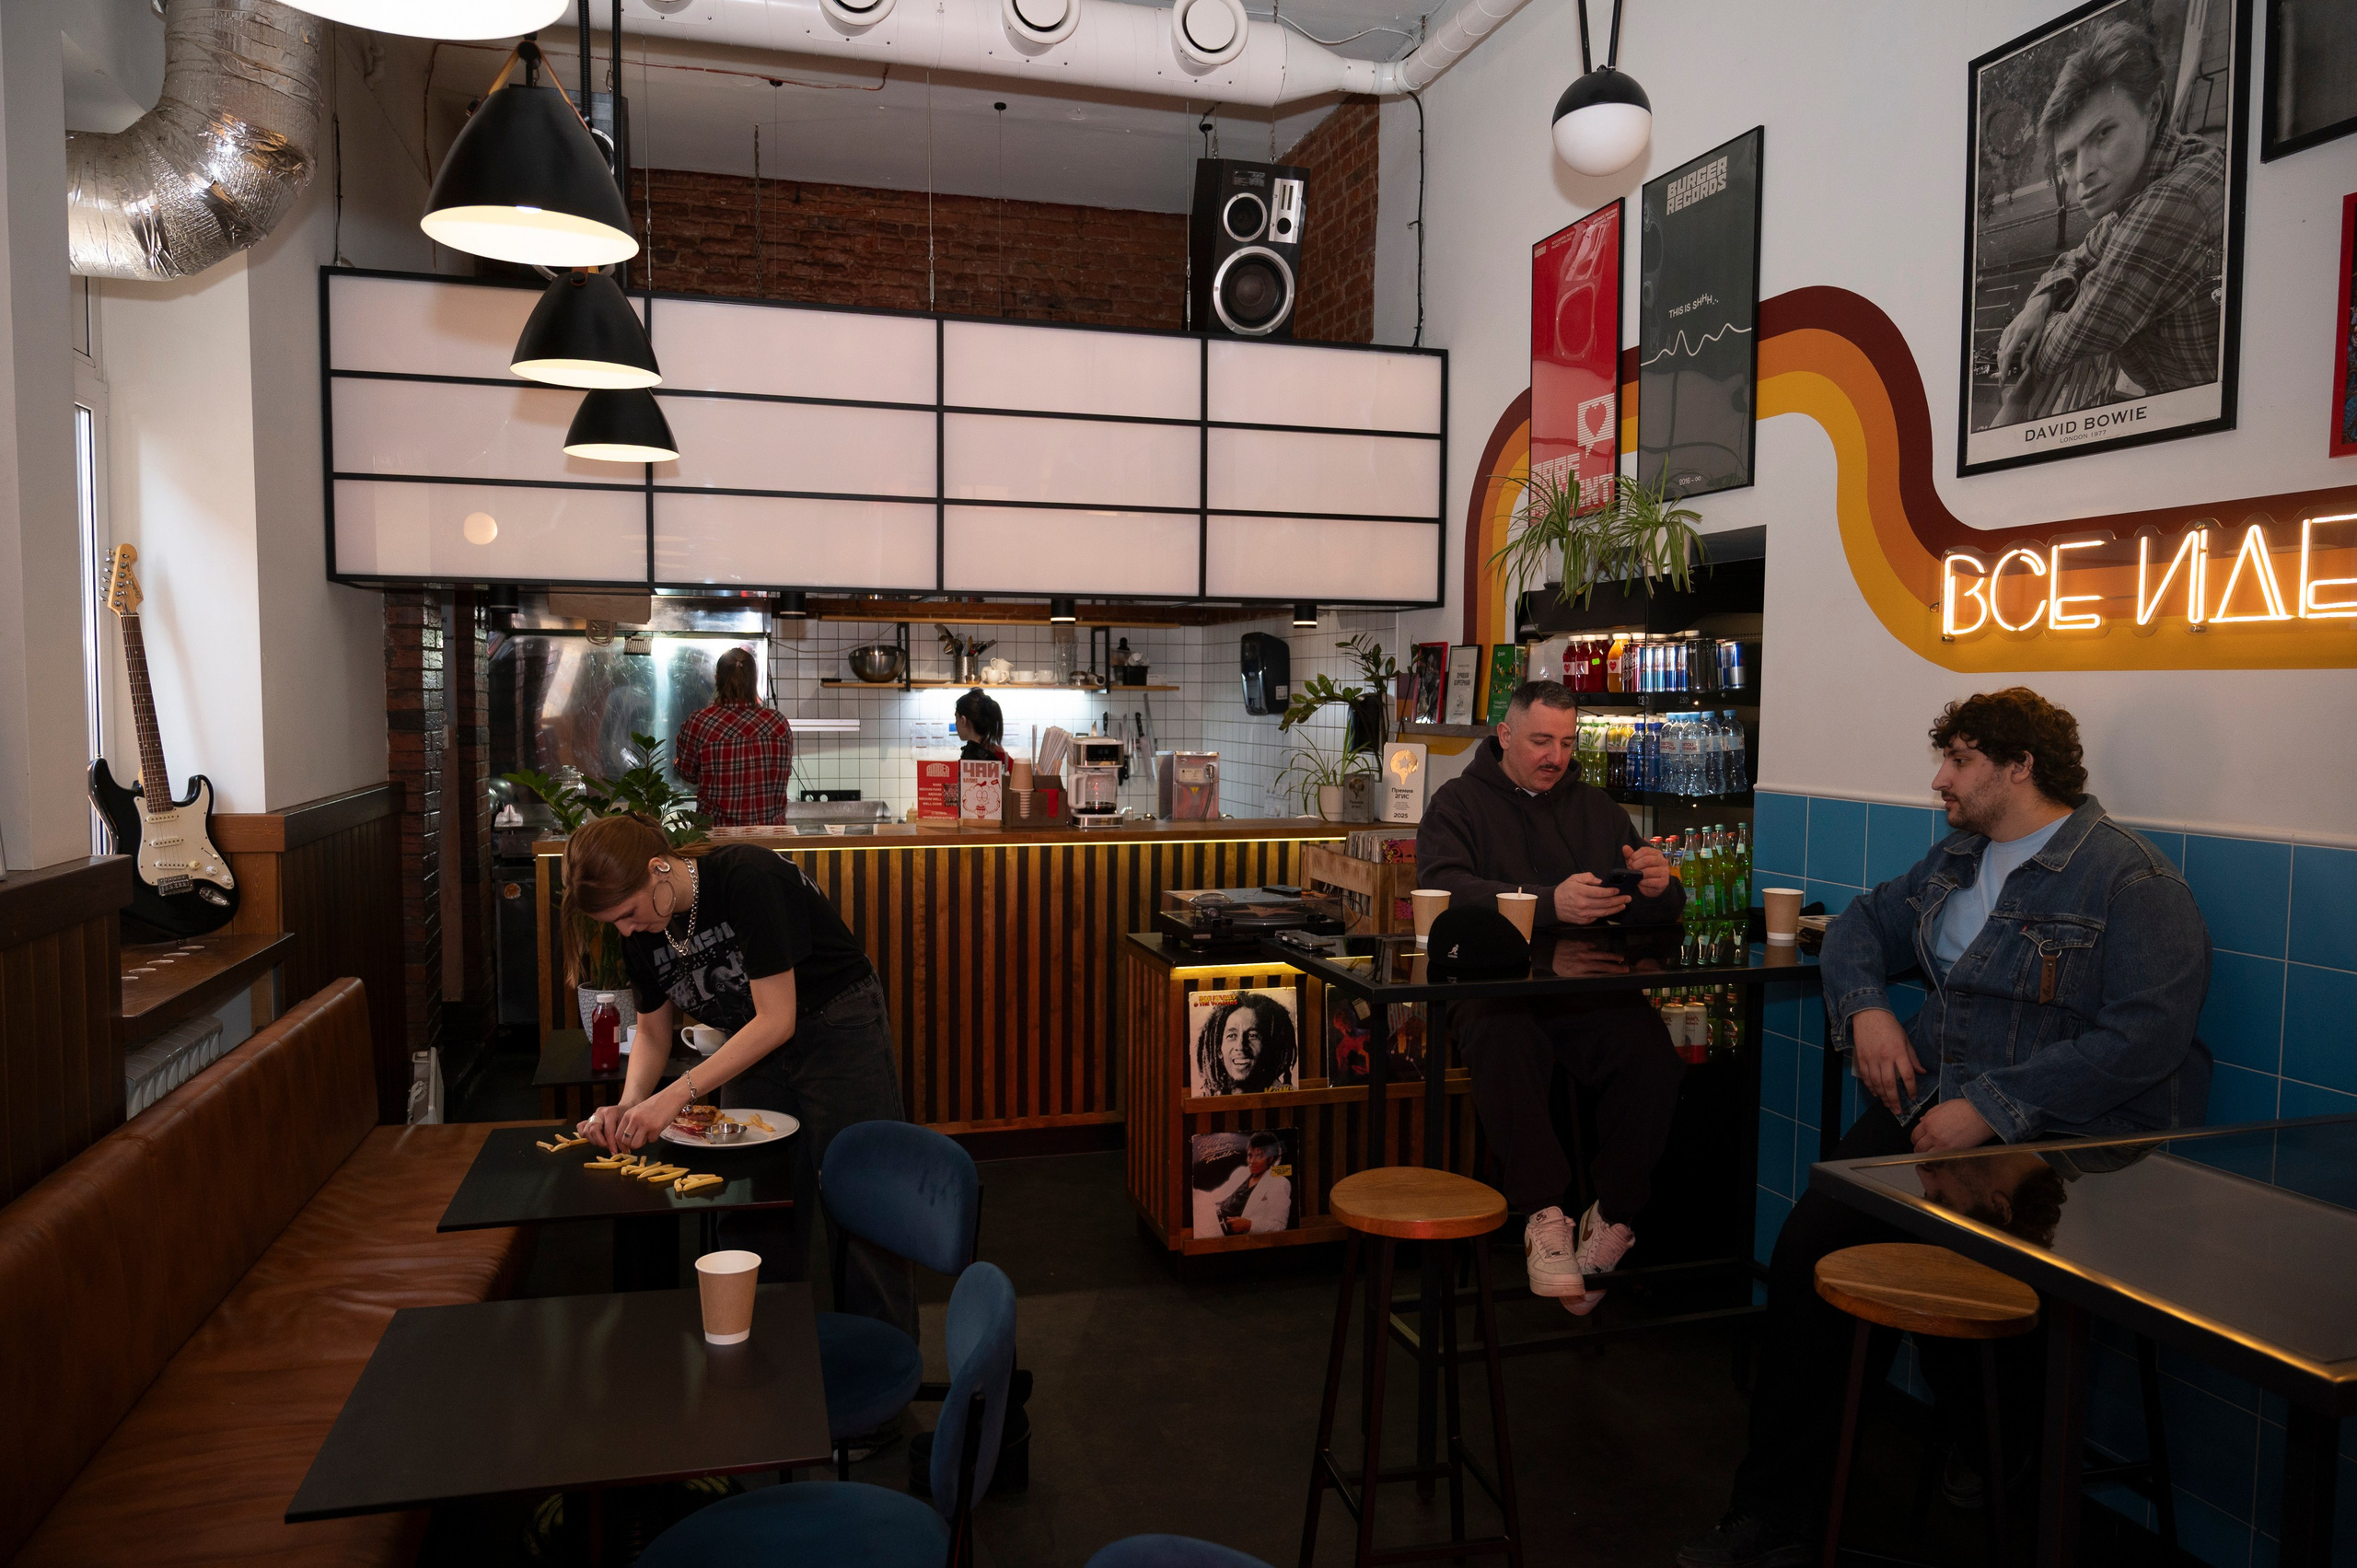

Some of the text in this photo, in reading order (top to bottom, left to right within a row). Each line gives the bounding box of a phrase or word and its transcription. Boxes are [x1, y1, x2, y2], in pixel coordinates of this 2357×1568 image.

[1666, 172, 1727, 215] RECORDS
[1667, 156, 1728, 200] BURGER
[1669, 306, 1684, 319] THIS
[1685, 303, 1691, 313] IS
[2025, 406, 2147, 442] DAVID BOWIE
[2060, 434, 2088, 443] LONDON
[1943, 540, 2106, 635] ВСЕ
[963, 762, 1000, 778] ЧАЙ
